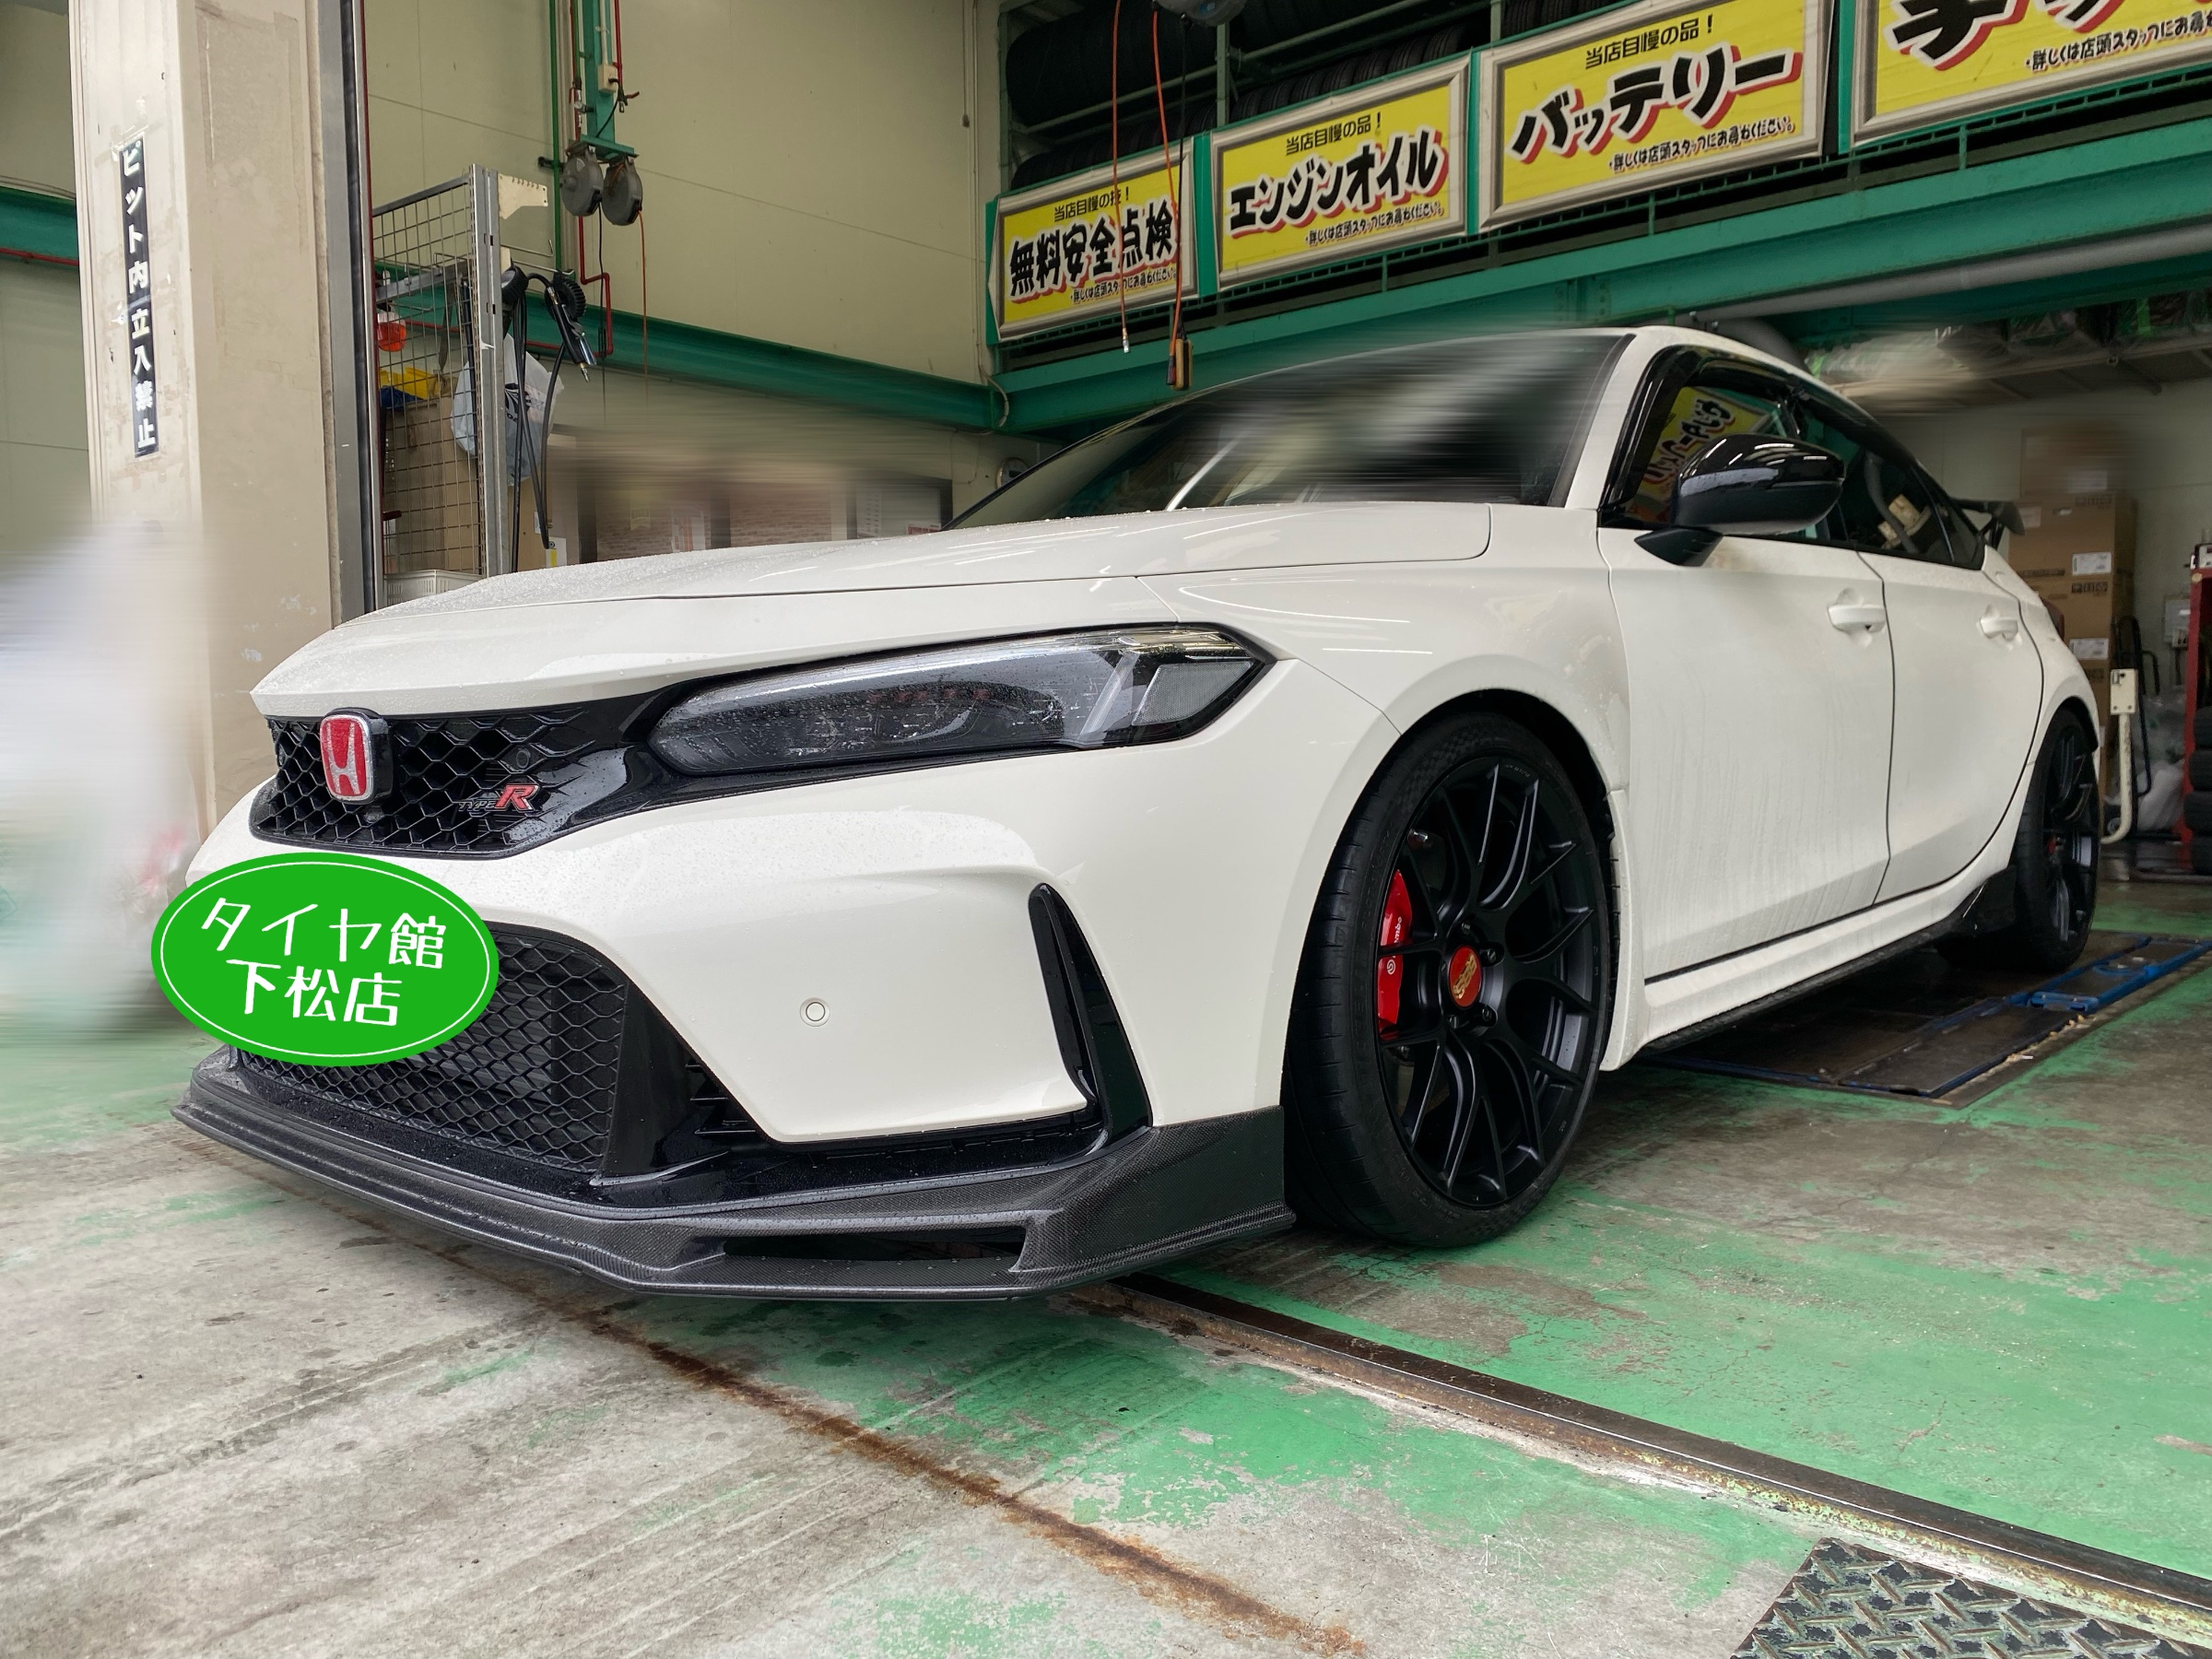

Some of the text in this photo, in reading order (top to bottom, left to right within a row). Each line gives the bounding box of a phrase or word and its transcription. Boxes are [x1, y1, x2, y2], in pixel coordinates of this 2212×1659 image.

[1585, 14, 1713, 69] 当店自慢の品！
[1286, 112, 1382, 156] 当店自慢の品！
[1512, 46, 1786, 155] バッテリー
[1230, 130, 1439, 230] エンジンオイル
[123, 140, 156, 449] ピット内立入禁止
[1010, 199, 1172, 296] 無料安全点検
[494, 783, 539, 812] R
